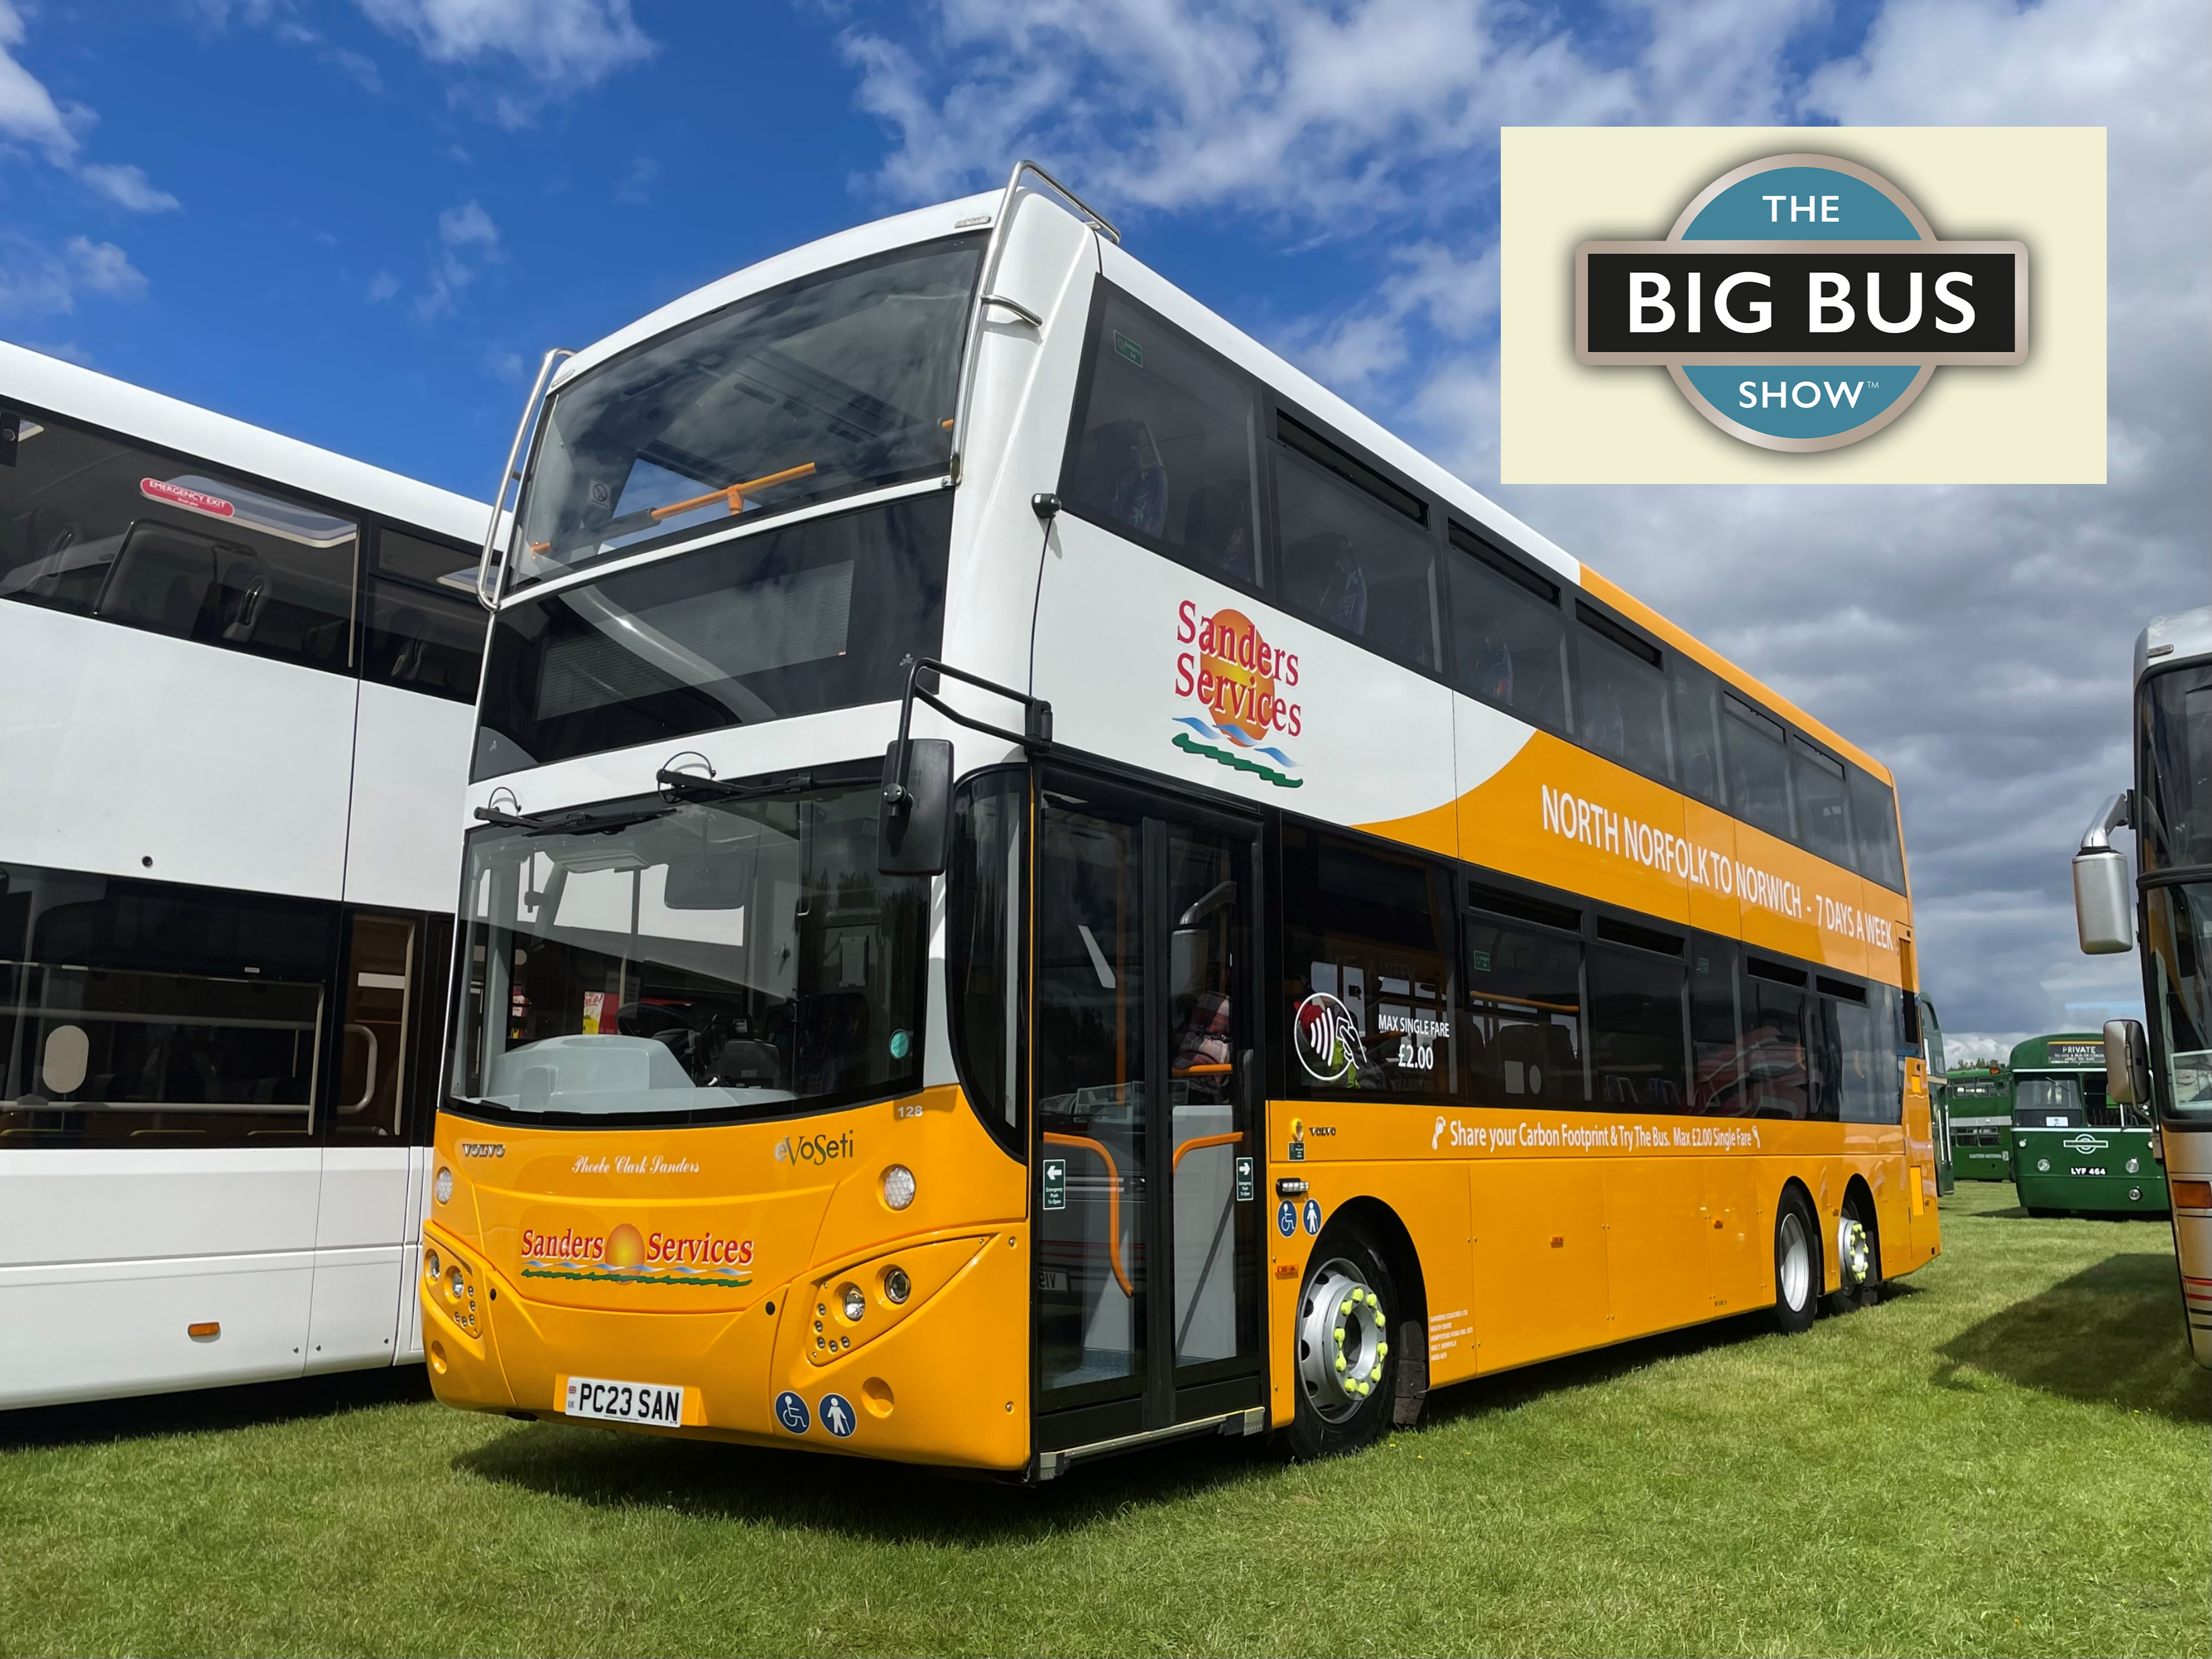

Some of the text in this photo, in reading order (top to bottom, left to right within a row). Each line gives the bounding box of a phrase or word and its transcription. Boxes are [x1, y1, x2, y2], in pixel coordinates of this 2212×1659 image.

[149, 481, 227, 508] EMERGENCY EXIT
[1177, 600, 1299, 686] Sanders
[1175, 652, 1302, 737] Services
[1542, 784, 1619, 855] NORTH
[1623, 816, 1711, 887] NORFOLK
[1710, 850, 1733, 895] TO
[1735, 861, 1802, 920] NORWICH
[1815, 894, 1823, 926] 7
[1825, 897, 1855, 938] DAYS
[1856, 910, 1865, 942] A
[1865, 912, 1894, 952] WEEK
[1378, 1013, 1450, 1038] MAX SINGLE FARE
[1398, 1044, 1434, 1070] £2.00
[898, 1105, 924, 1118] 128
[1308, 1127, 1336, 1136] VOLVO
[1450, 1119, 1752, 1153] Share your Carbon Footprint & Try The Bus. Max £2.00 Single Fare
[462, 1144, 505, 1158] VOLVO
[615, 1156, 648, 1174] Clark
[650, 1155, 700, 1174] Sanders
[521, 1227, 755, 1266] Sanders Services
[579, 1382, 680, 1421] PC23 SAN
